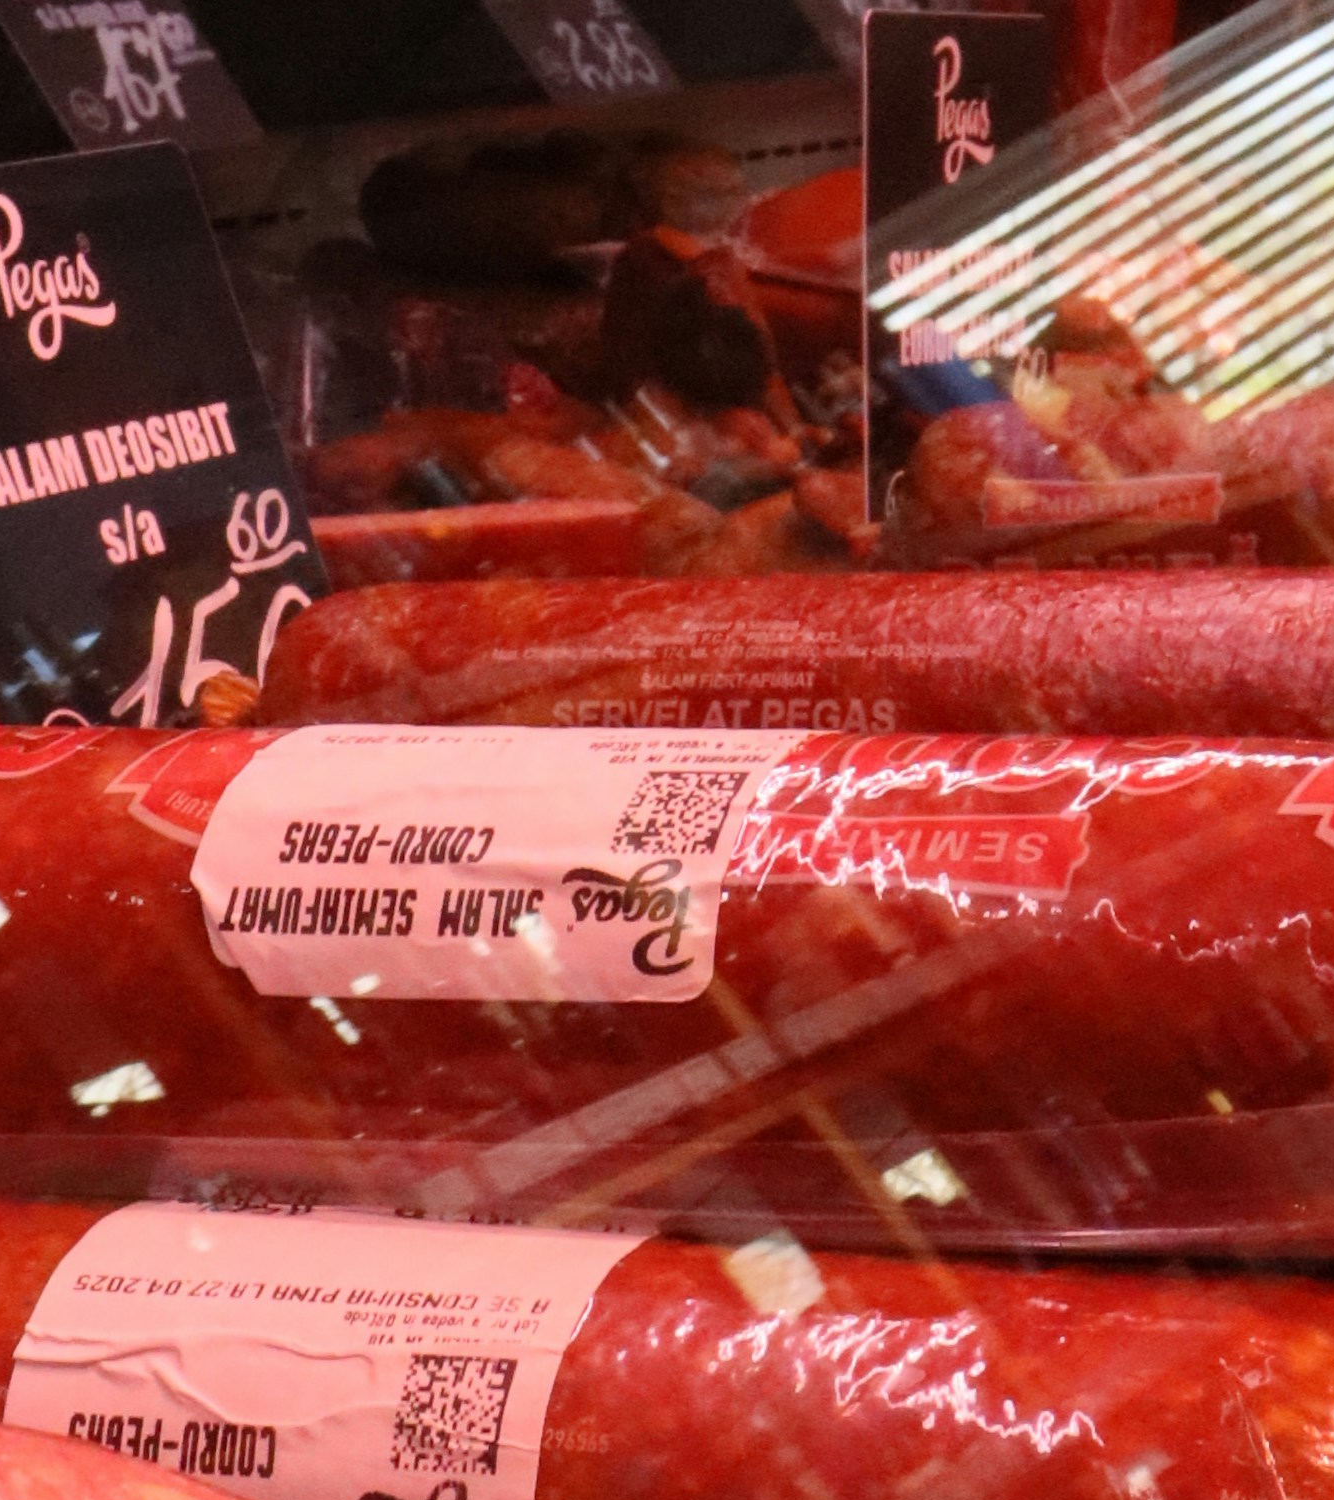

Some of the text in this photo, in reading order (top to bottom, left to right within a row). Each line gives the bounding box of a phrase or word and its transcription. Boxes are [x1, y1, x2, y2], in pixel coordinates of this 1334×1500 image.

[82, 402, 237, 490] DEOSIBIT
[100, 504, 165, 567] s/a
[227, 487, 292, 562] 60
[551, 697, 897, 735] SERVELAT PEGAS
[278, 821, 496, 866] CODRU-PEGAS
[218, 886, 544, 939] SALAM SEMIAFUMAT
[561, 857, 695, 977] Pegas
[272, 1284, 342, 1304] PINA
[347, 1290, 479, 1311] CONSUMA
[488, 1294, 524, 1313] SE
[530, 1298, 552, 1314] A
